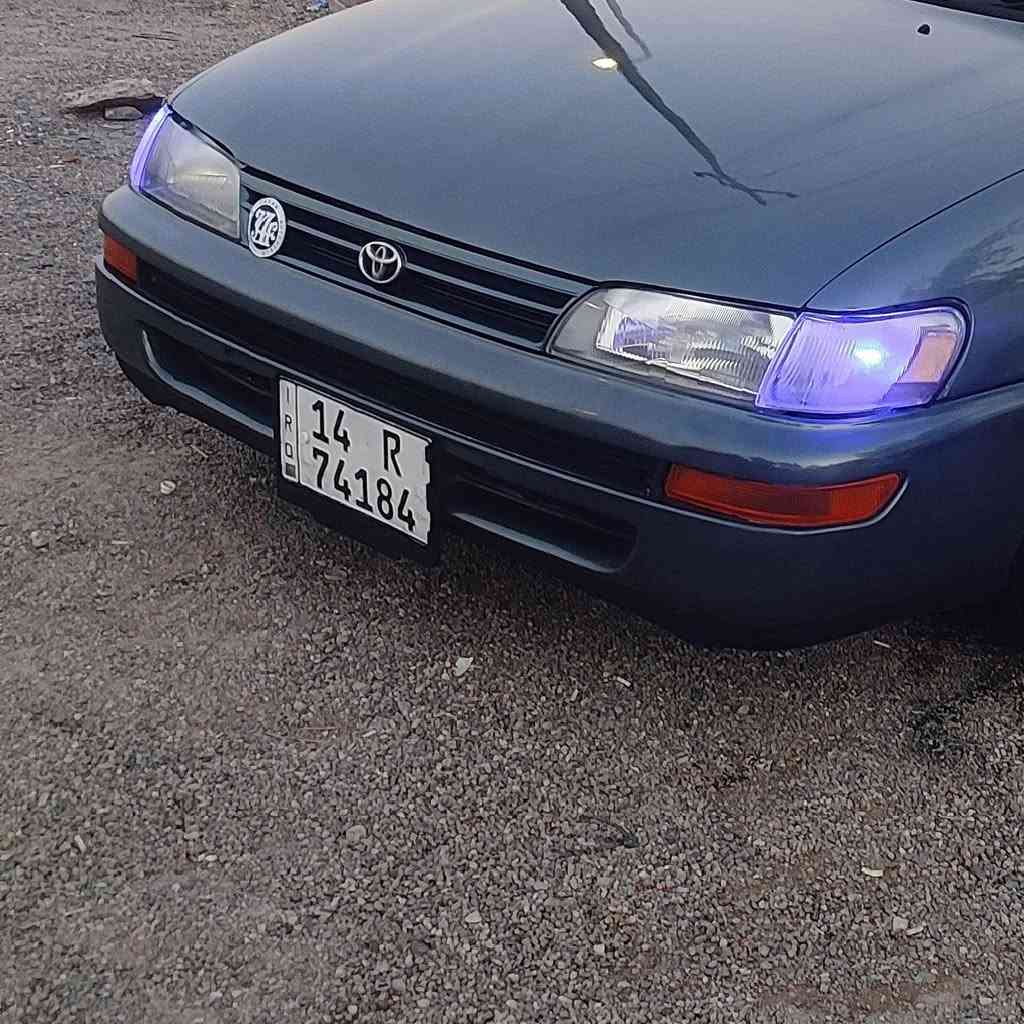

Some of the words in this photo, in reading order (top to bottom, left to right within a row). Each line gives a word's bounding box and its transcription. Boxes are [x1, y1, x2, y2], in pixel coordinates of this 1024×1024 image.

[312, 399, 351, 453] 14
[383, 428, 402, 477] R
[312, 446, 416, 531] 74184
